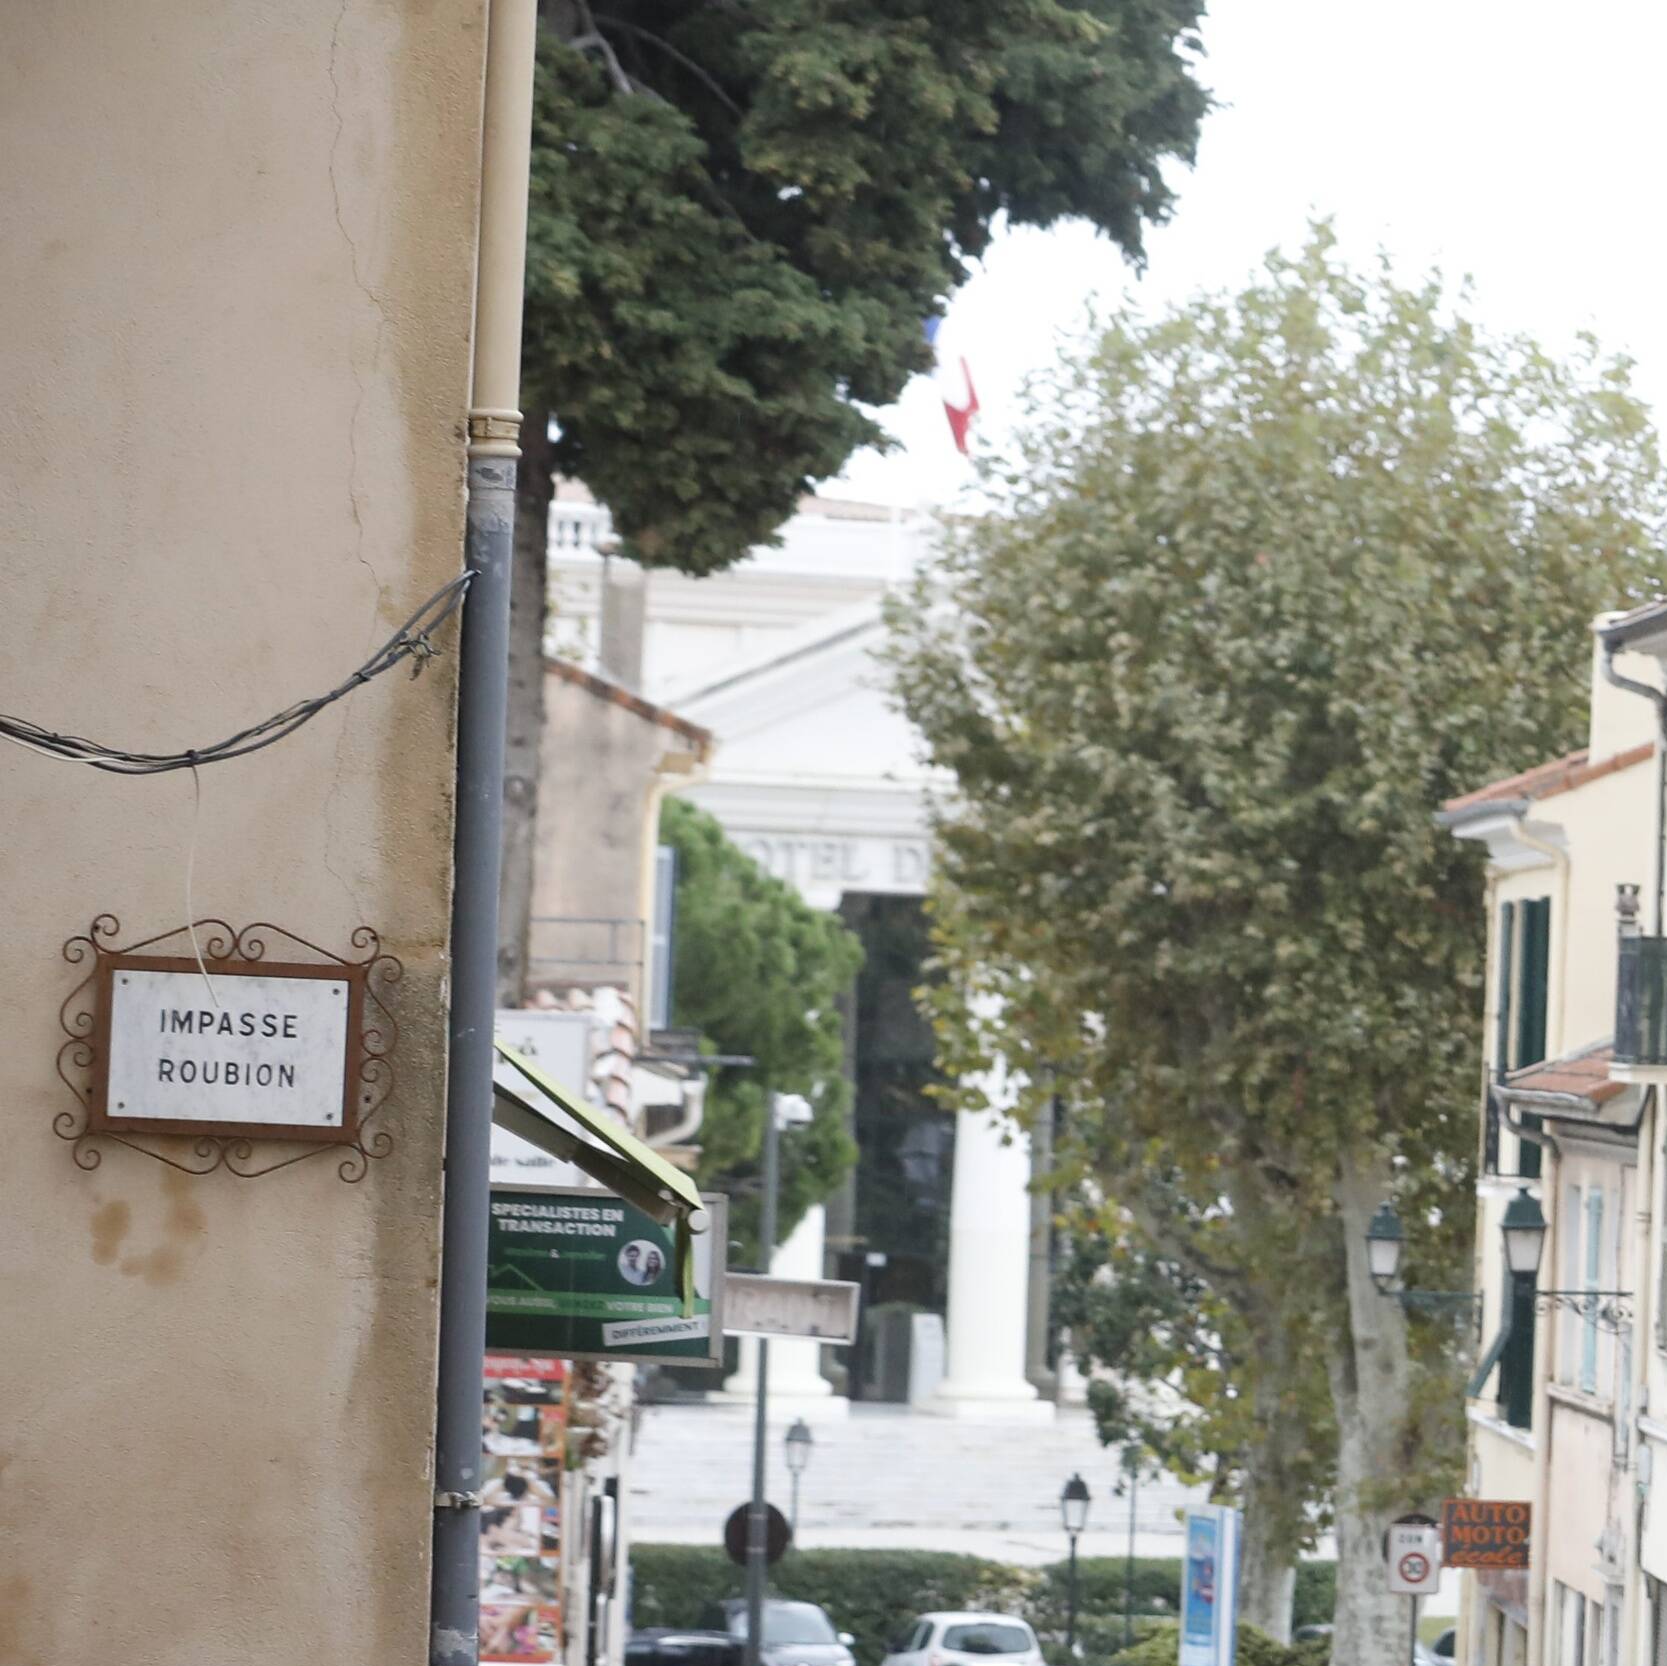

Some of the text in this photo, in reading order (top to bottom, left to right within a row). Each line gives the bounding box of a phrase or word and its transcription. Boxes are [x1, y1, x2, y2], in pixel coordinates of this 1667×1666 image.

[745, 839, 869, 882] OTEL
[159, 1008, 298, 1039] IMPASSE
[158, 1058, 295, 1088] ROUBION
[603, 1208, 624, 1222] EN
[497, 1218, 616, 1237] TRANSACTION
[1453, 1503, 1528, 1523] AUTO
[1451, 1525, 1526, 1545] MOTO
